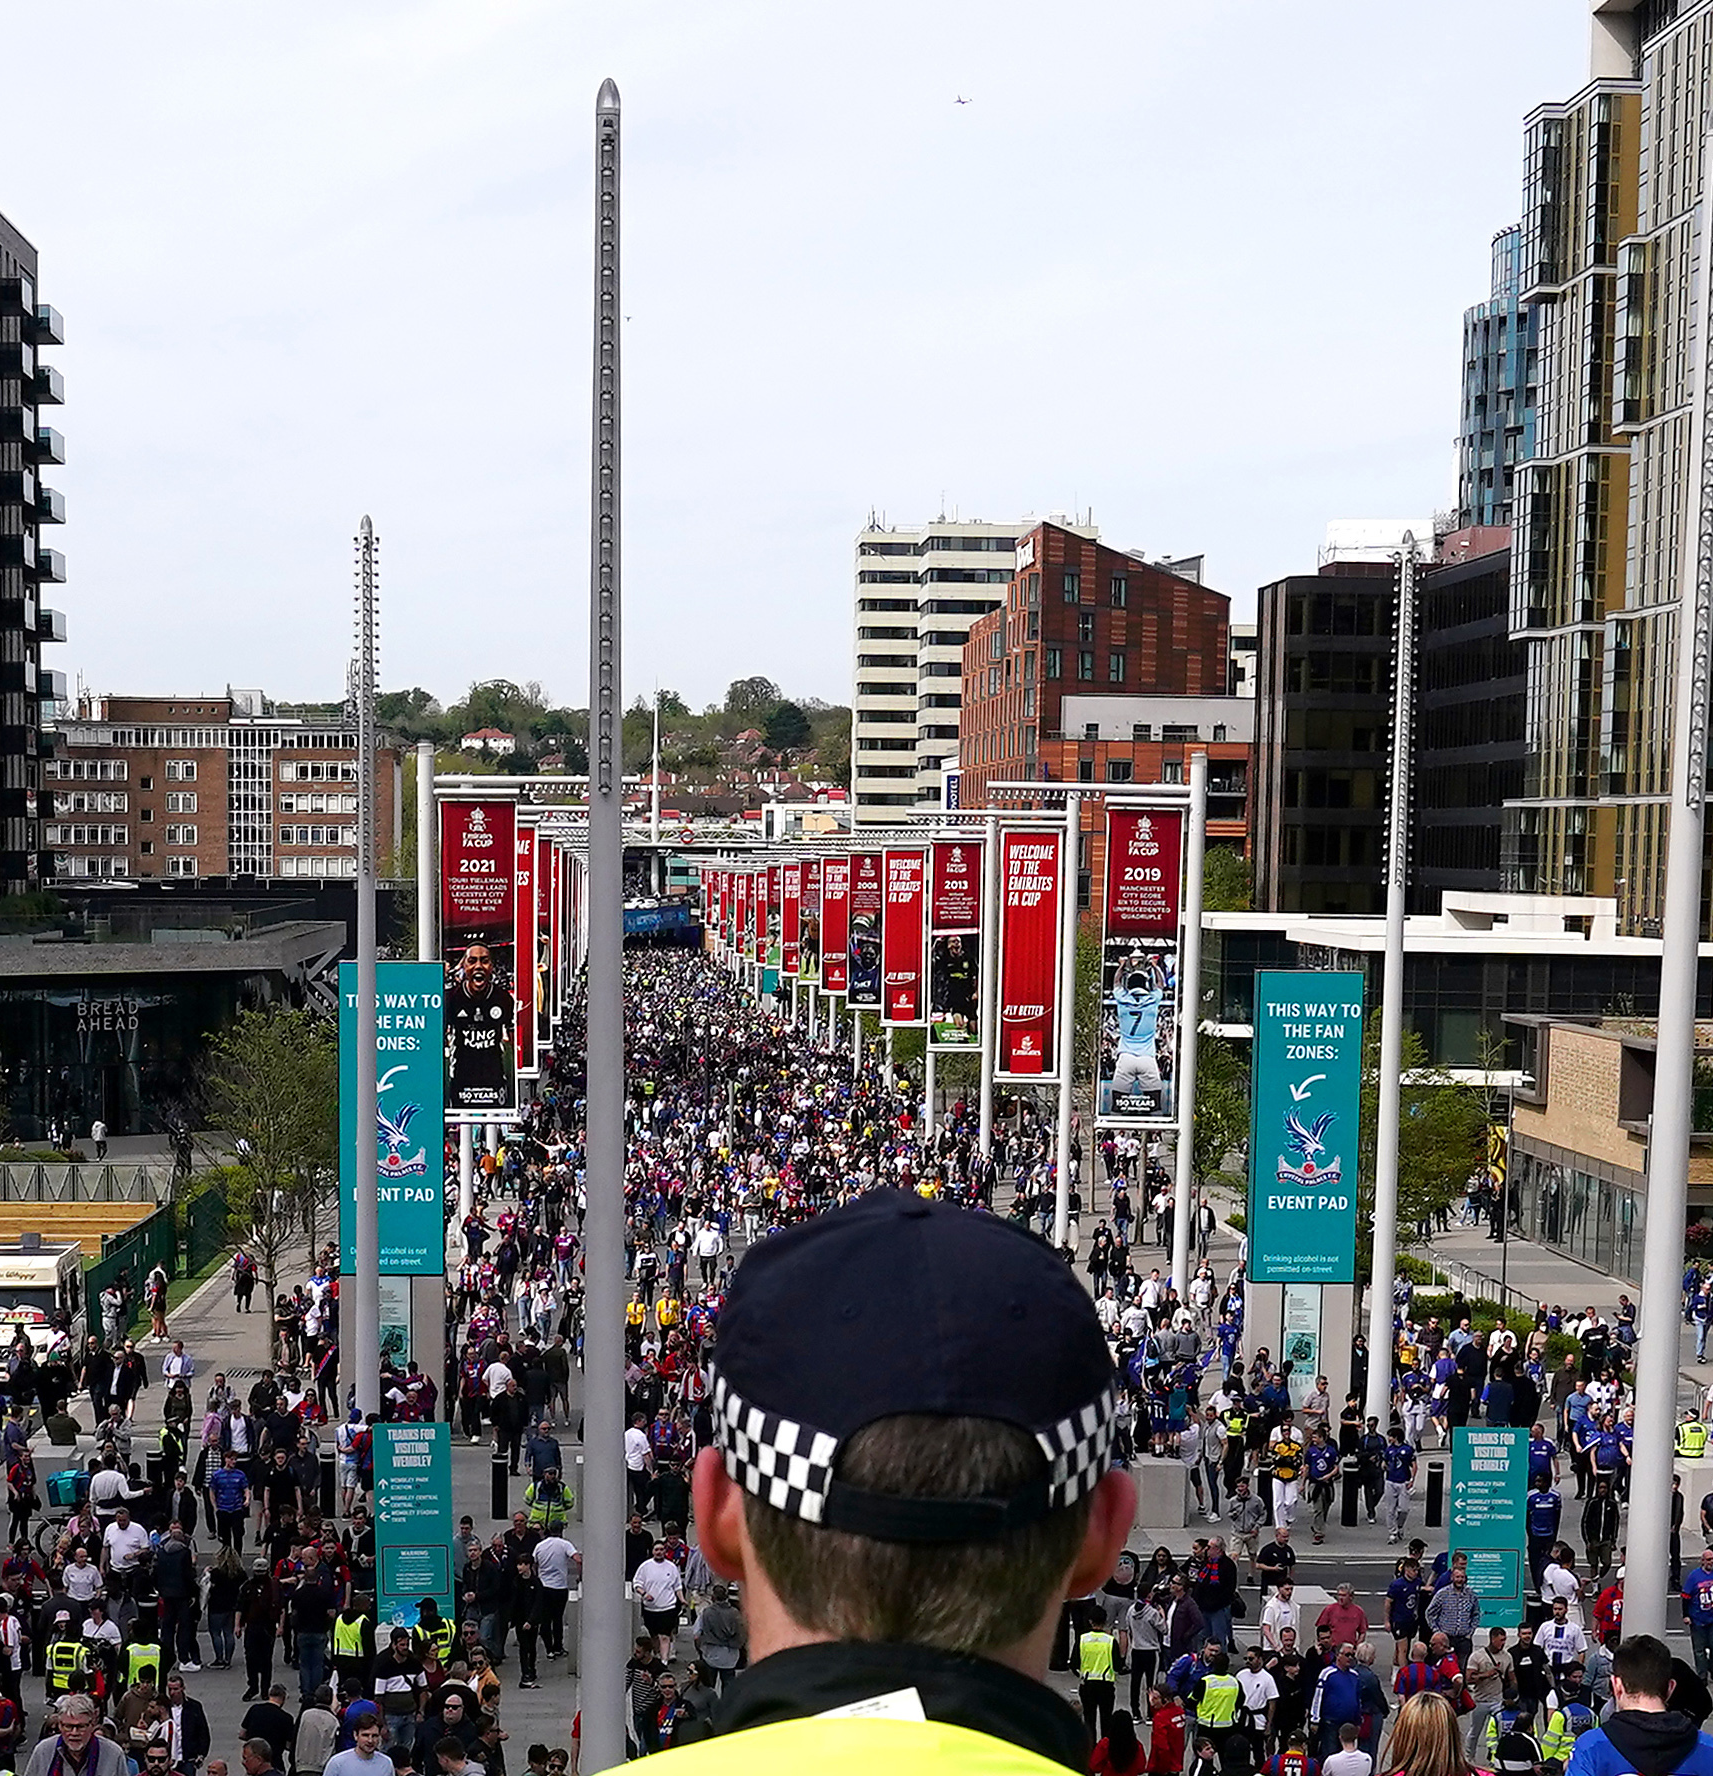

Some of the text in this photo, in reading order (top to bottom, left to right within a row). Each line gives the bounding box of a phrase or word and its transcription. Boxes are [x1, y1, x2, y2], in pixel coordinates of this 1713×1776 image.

[462, 839, 494, 848] FA CUP
[1009, 845, 1055, 860] WELCOME
[1128, 847, 1160, 856] FA CUP
[459, 859, 496, 873] 2021
[889, 858, 922, 870] WELCOME
[1008, 860, 1041, 875] TO THE
[889, 870, 912, 881] TO THE
[1124, 867, 1162, 881] 2019
[888, 880, 922, 892] EMIRATES
[944, 880, 969, 890] 2013
[1008, 875, 1054, 892] EMIRATES
[1007, 891, 1042, 907] FA CUP
[77, 1001, 139, 1016] BREAD
[384, 994, 442, 1009] WAY TO
[1266, 1002, 1362, 1019] THIS WAY TO
[76, 1016, 139, 1032] AHEAD
[376, 1015, 426, 1029] HE FAN
[1129, 1010, 1143, 1036] 7
[1282, 1023, 1345, 1039] THE FAN
[376, 1036, 421, 1051] ONES:
[1286, 1045, 1339, 1060] ZONES:
[473, 1091, 499, 1099] YEARS
[1131, 1099, 1156, 1107] YEARS
[404, 1187, 435, 1202] PAD
[1268, 1195, 1349, 1211] EVENT PAD
[380, 1246, 428, 1255] alcohol is not
[1262, 1254, 1340, 1264] Drinking alcohol is not
[1266, 1265, 1300, 1274] permitted
[387, 1428, 436, 1440] THANKS FOR
[1468, 1432, 1516, 1445] THANKS FOR
[1474, 1446, 1508, 1458] VISITING
[392, 1455, 433, 1468] WEMBLEY
[1470, 1459, 1510, 1472] WEMBLEY
